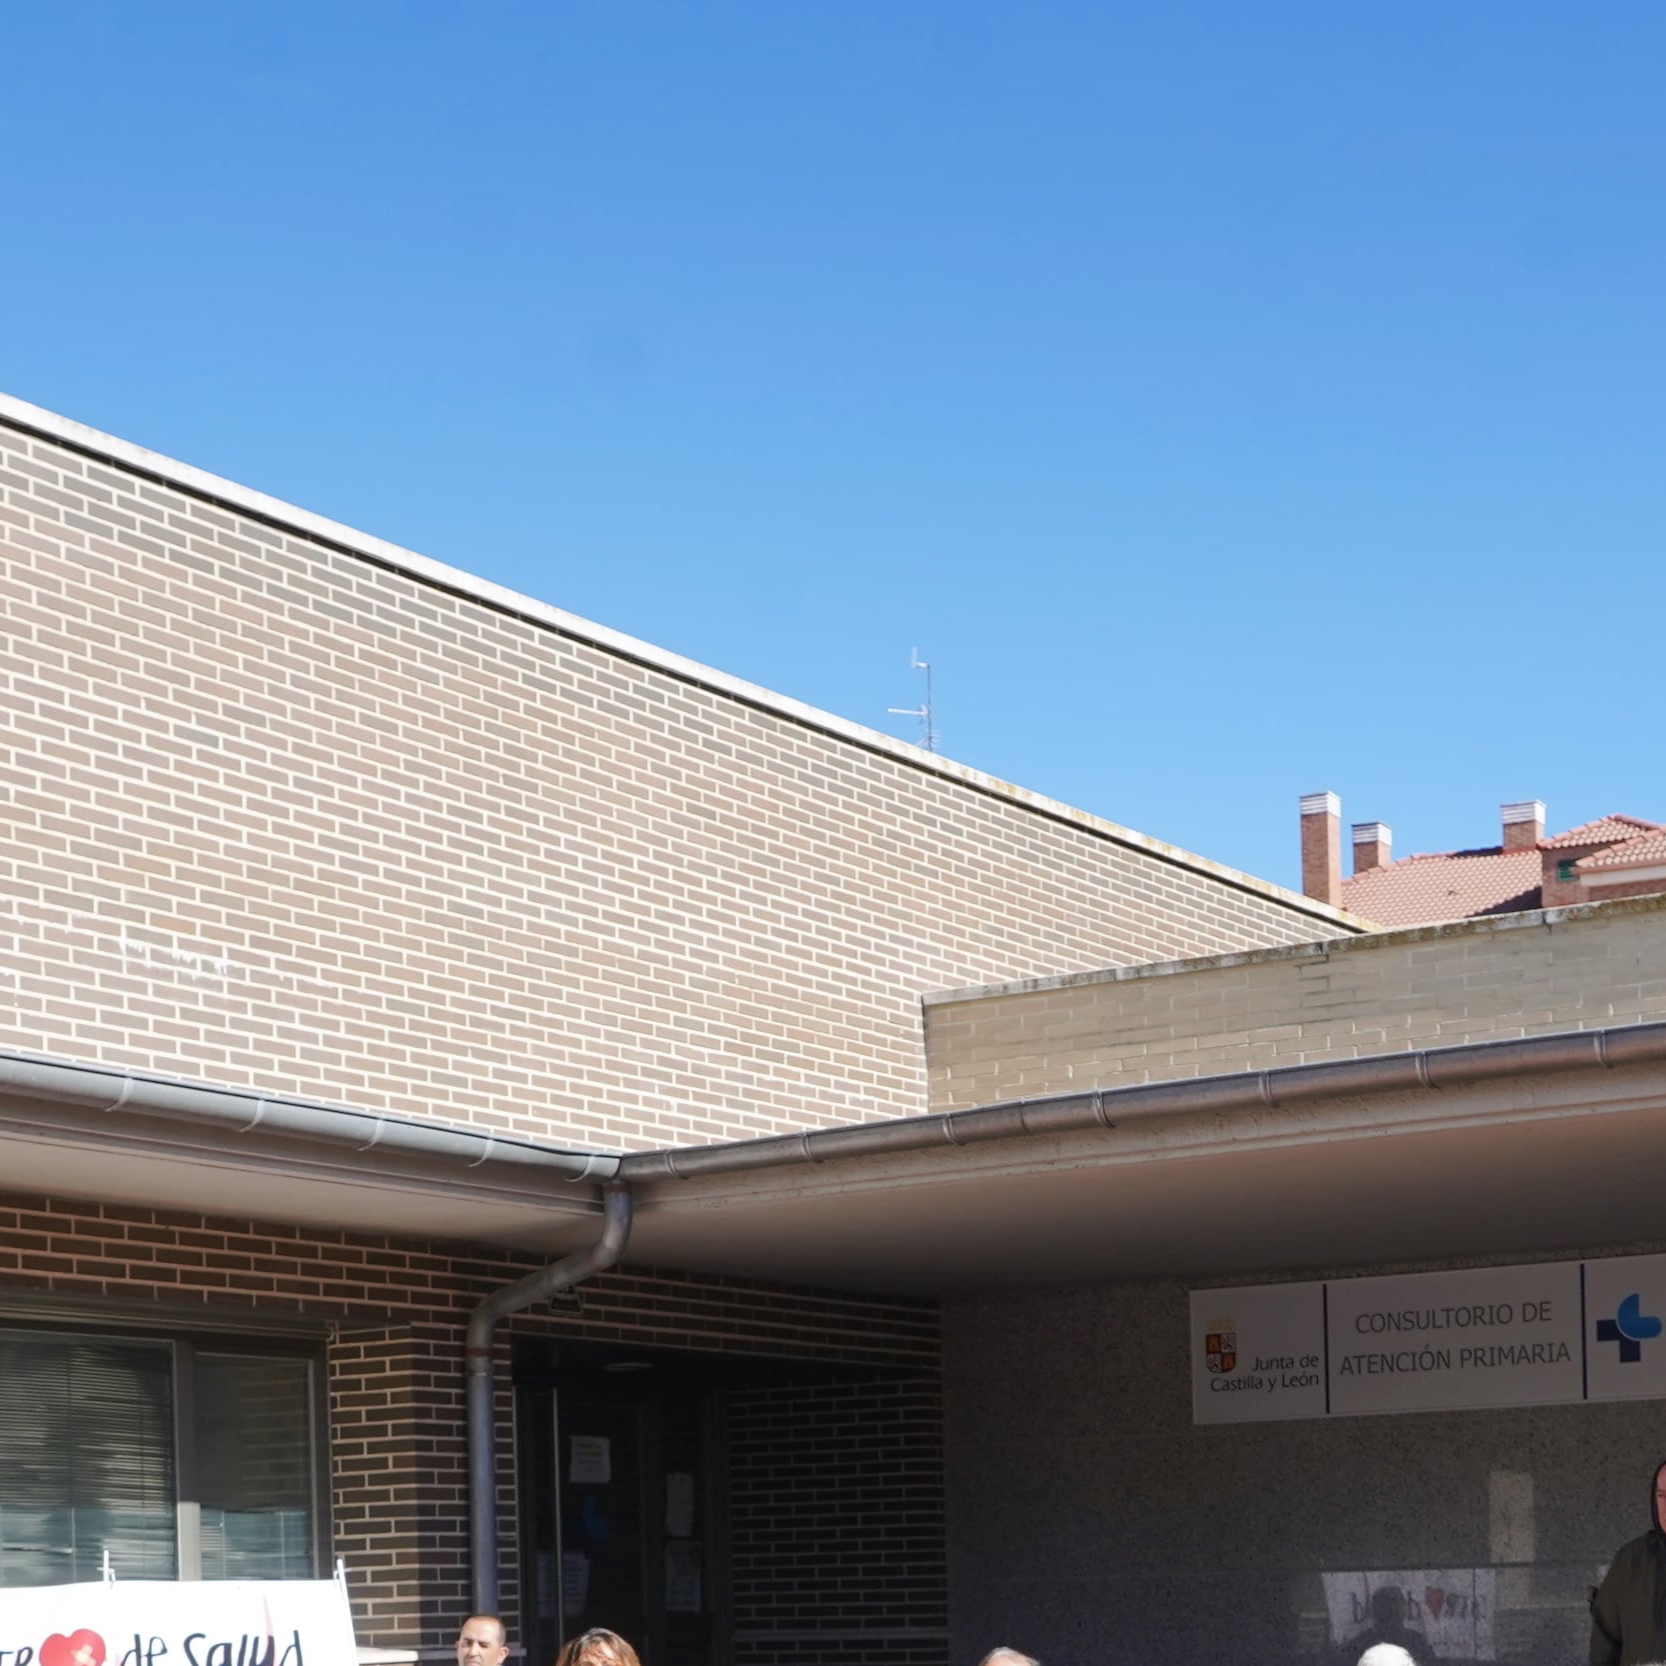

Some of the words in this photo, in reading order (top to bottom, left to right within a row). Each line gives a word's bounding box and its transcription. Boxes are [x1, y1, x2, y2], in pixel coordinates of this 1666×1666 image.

[1355, 1305, 1513, 1335] CONSULTORIO
[1522, 1301, 1552, 1323] DE
[1251, 1355, 1294, 1372] Junta
[1299, 1353, 1319, 1368] de
[1340, 1344, 1451, 1375] ATENCIÓN
[1461, 1342, 1570, 1368] PRIMARIA
[1210, 1374, 1263, 1393] Castilla
[1266, 1378, 1277, 1393] y
[1281, 1371, 1319, 1388] León
